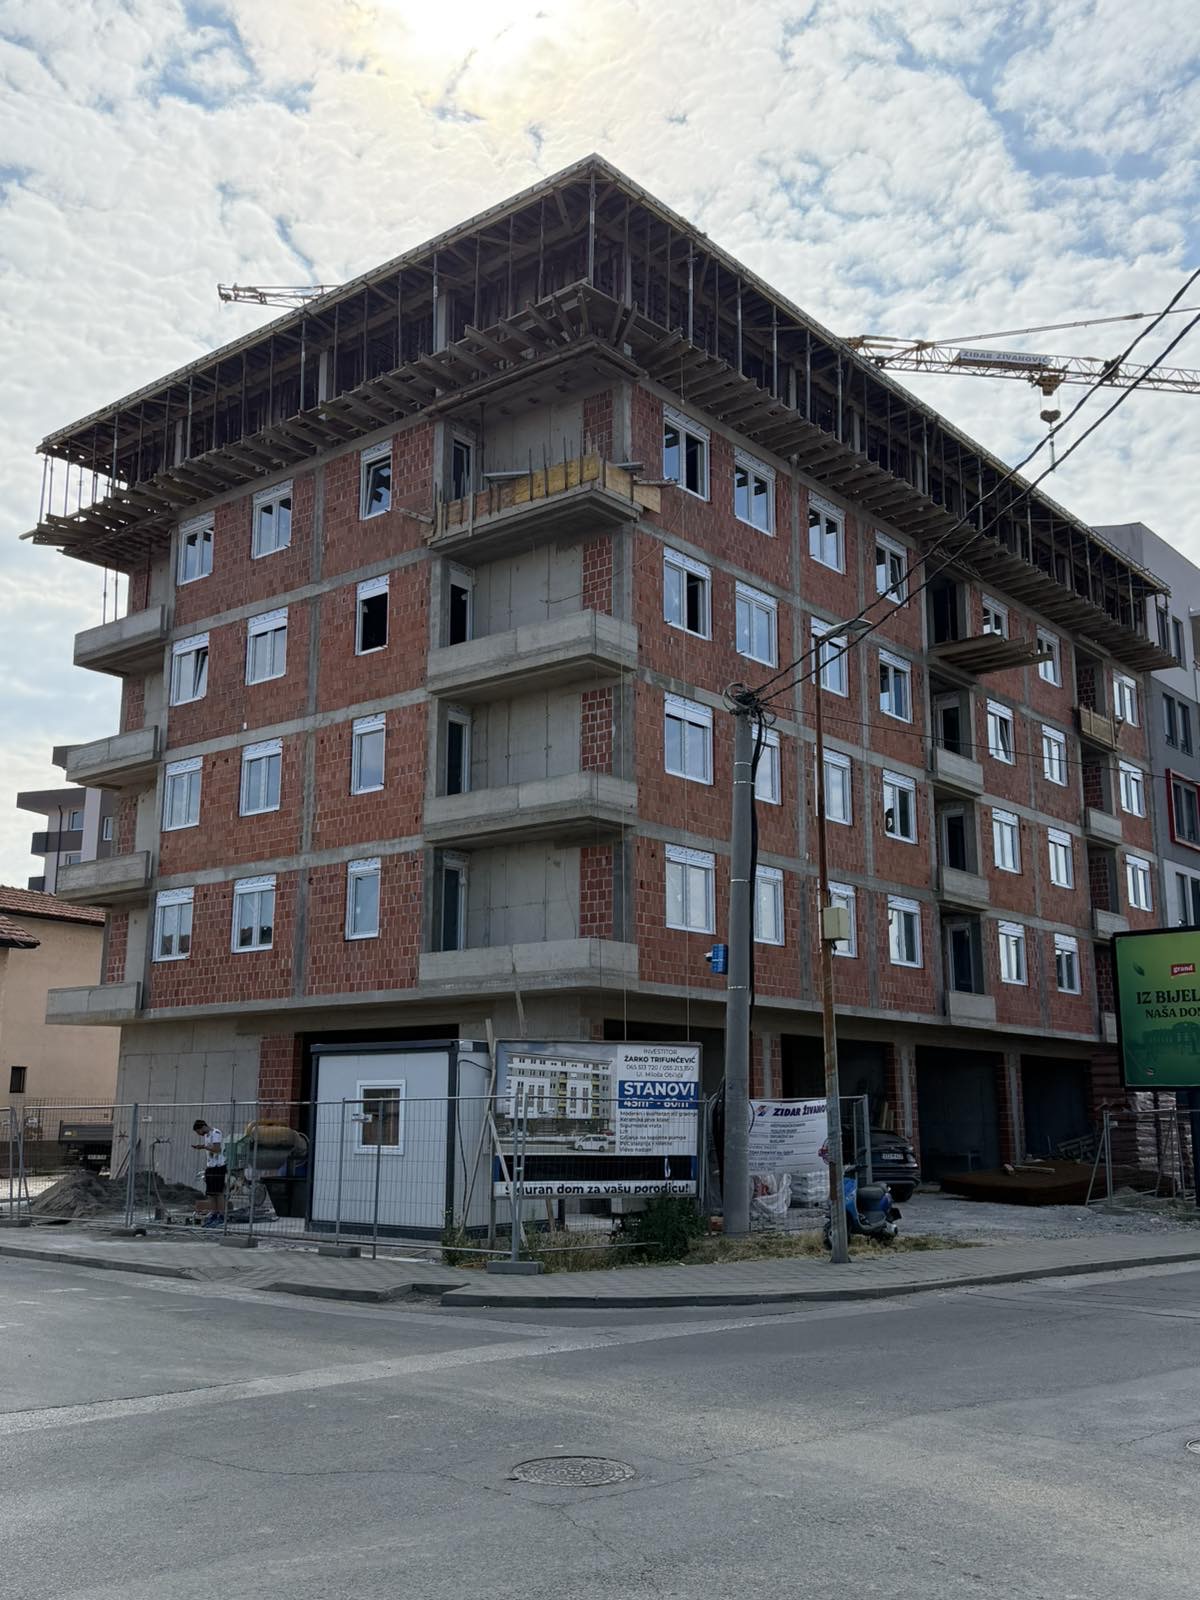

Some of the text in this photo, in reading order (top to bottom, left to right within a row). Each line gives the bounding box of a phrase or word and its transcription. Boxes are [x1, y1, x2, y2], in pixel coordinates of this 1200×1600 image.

[1136, 991, 1152, 1005] IZ
[1145, 1005, 1177, 1019] NAŠA
[624, 1055, 649, 1063] ŽARKO
[624, 1082, 695, 1096] STANOVI
[772, 1104, 826, 1117] ZIDAR ŽIVANO
[557, 1183, 584, 1194] dom
[587, 1185, 601, 1194] za
[603, 1183, 631, 1194] vašu
[634, 1182, 690, 1195] porodicu!
